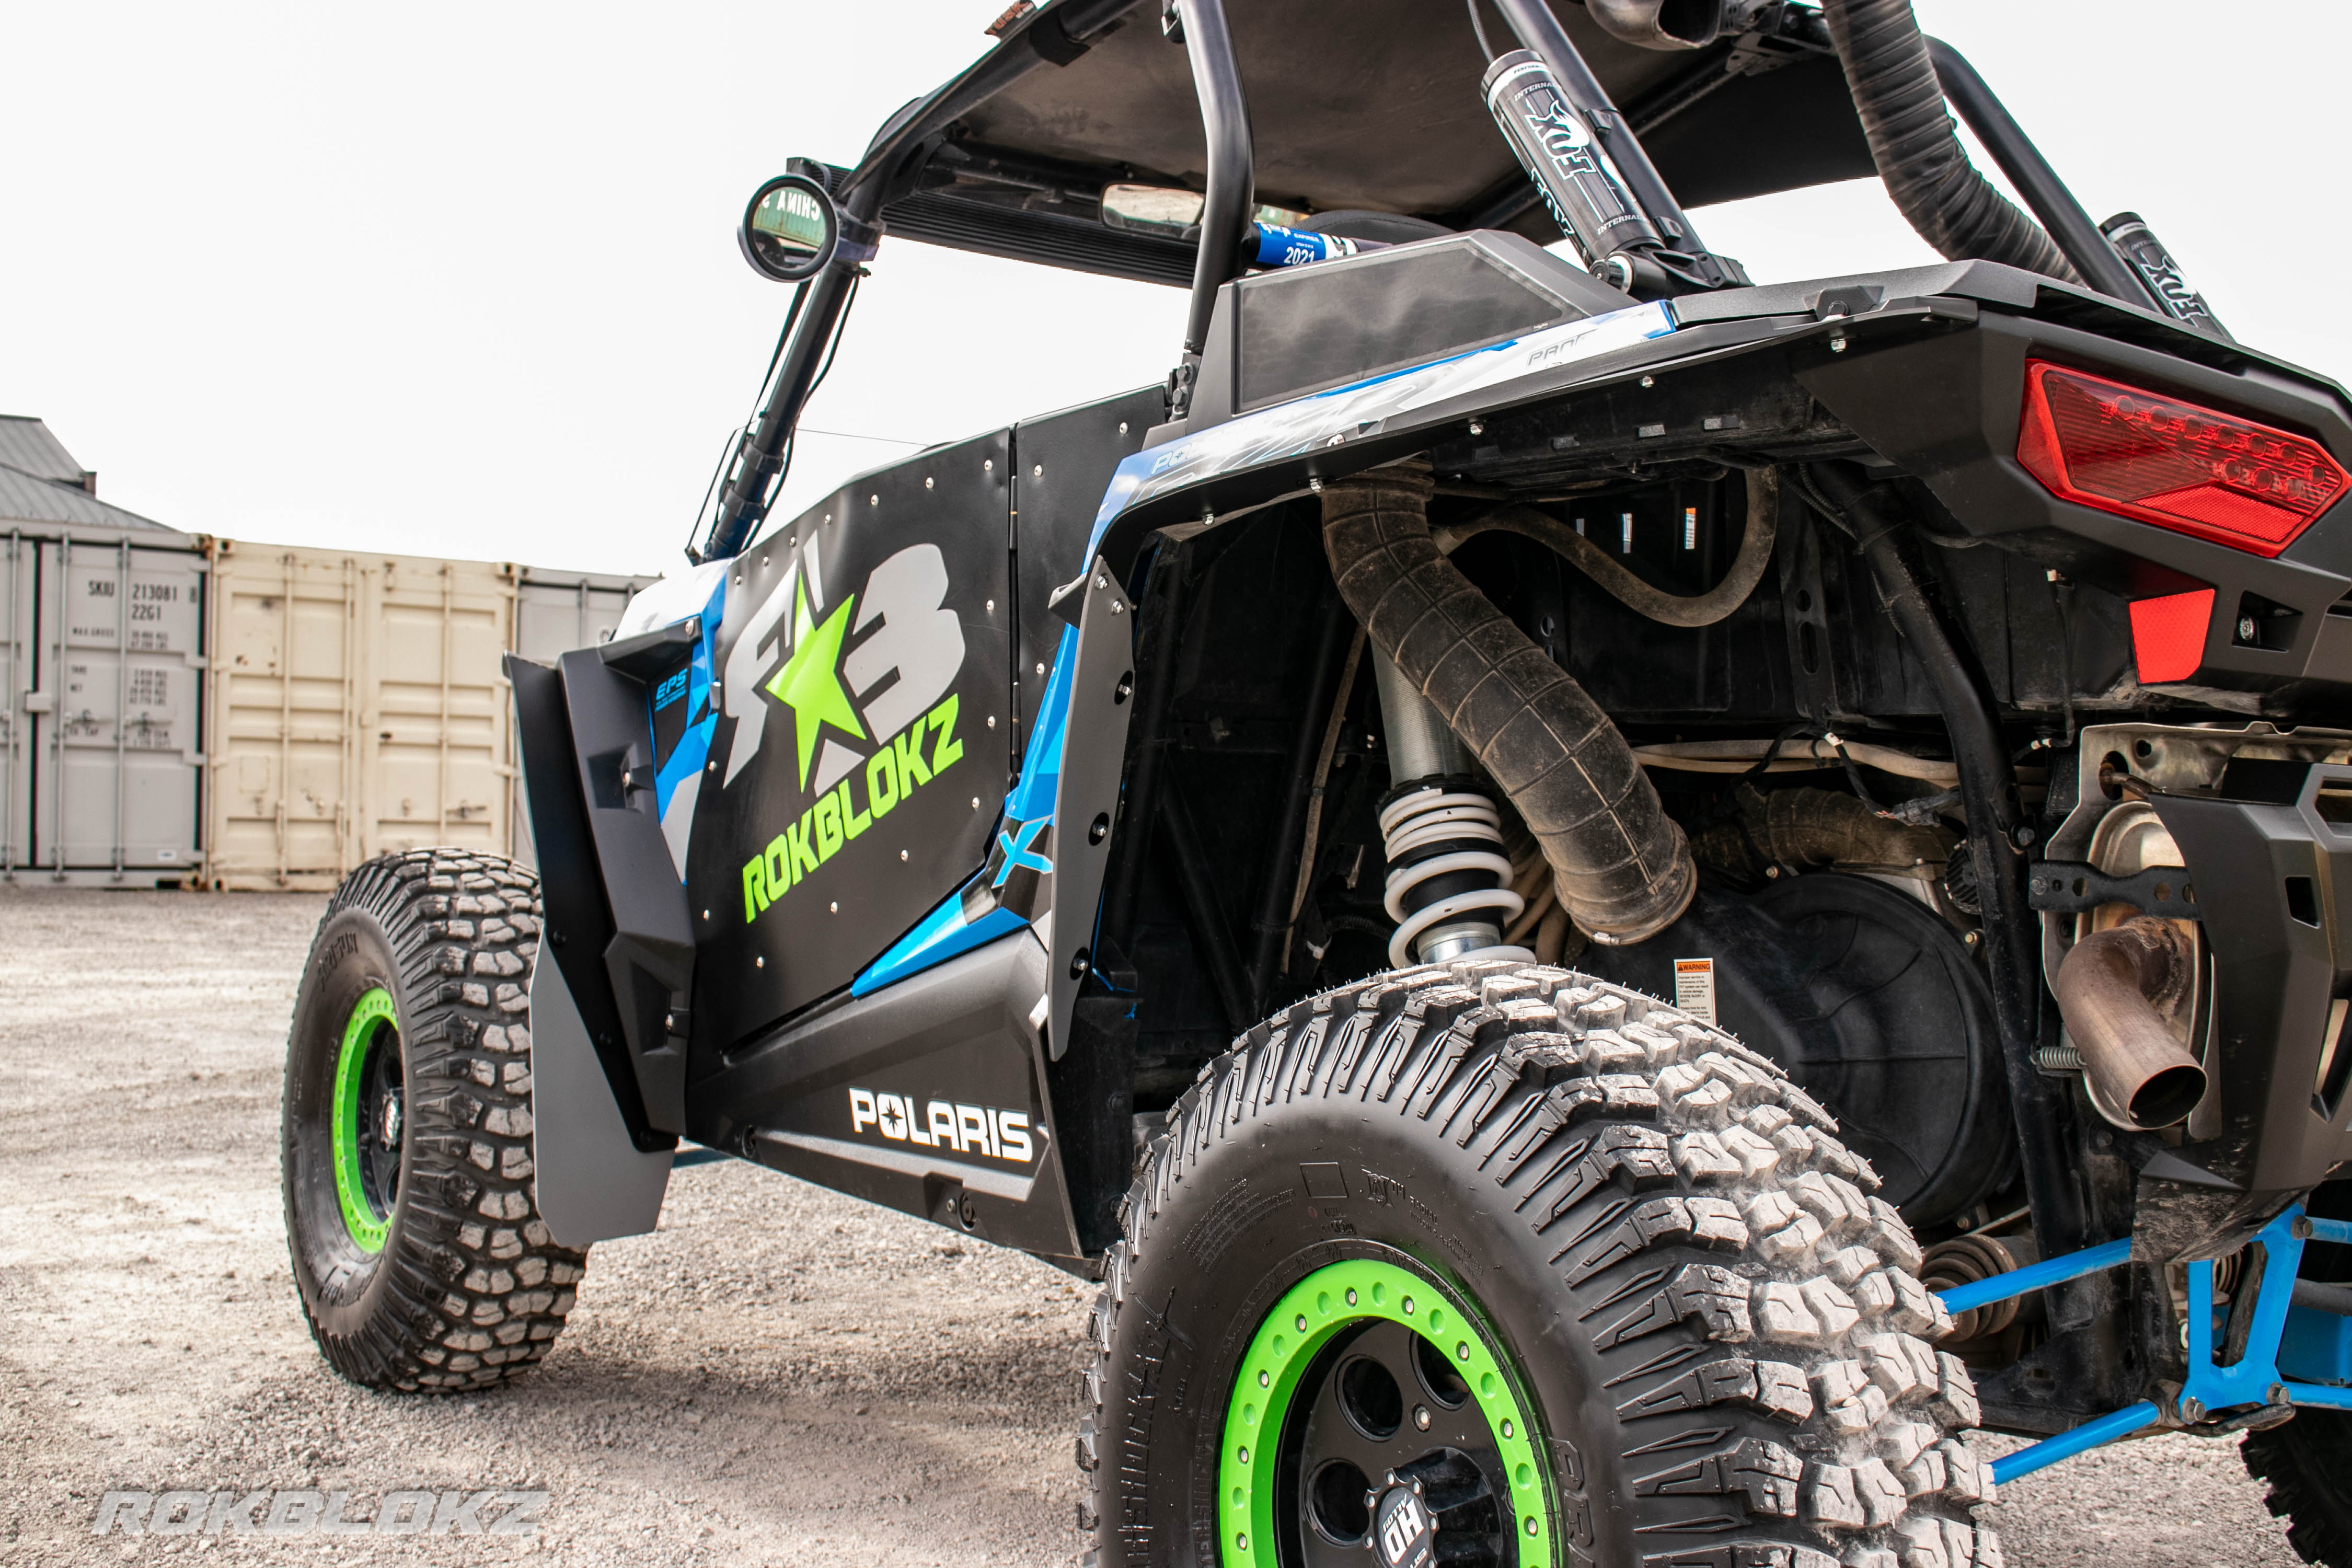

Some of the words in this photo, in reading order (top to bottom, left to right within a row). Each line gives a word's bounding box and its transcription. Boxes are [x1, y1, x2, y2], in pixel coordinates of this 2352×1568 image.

[1284, 246, 1315, 265] 2021
[88, 580, 115, 597] SKIU
[132, 583, 178, 601] 213081
[656, 667, 688, 700] EPS
[742, 693, 964, 924] ROKBLOKZ
[848, 1087, 1033, 1162] POLARIS
[1385, 1497, 1425, 1564] HD
